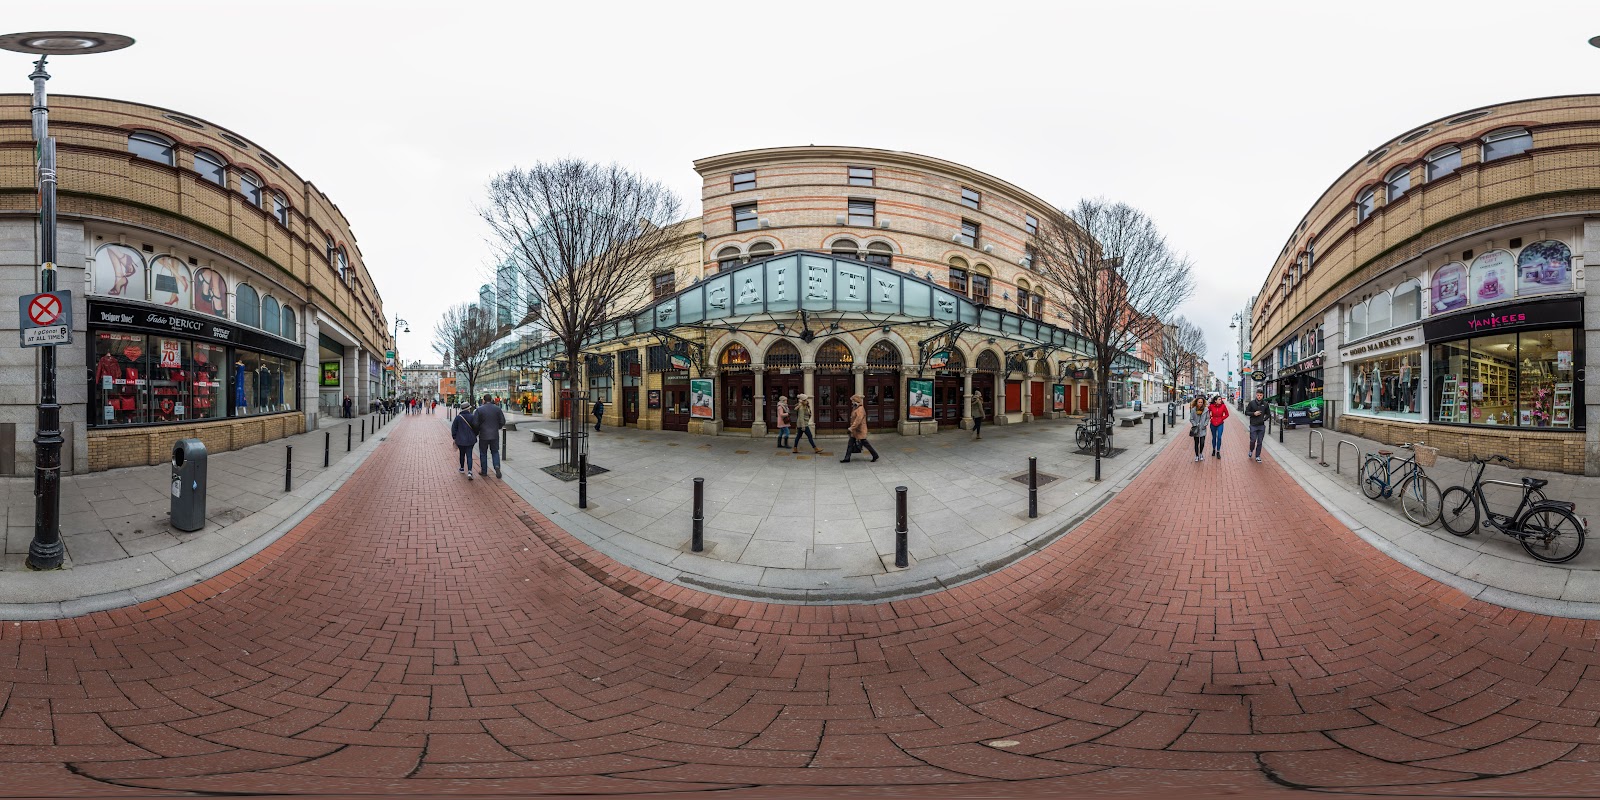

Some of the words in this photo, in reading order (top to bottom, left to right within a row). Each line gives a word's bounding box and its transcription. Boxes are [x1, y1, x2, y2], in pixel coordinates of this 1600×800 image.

[708, 265, 896, 310] GAIETY
[146, 313, 168, 325] Fabio
[168, 316, 201, 331] DERICCI
[1468, 313, 1526, 328] YANKEES
[212, 327, 230, 335] OUTLET
[1367, 336, 1402, 352] MARKET
